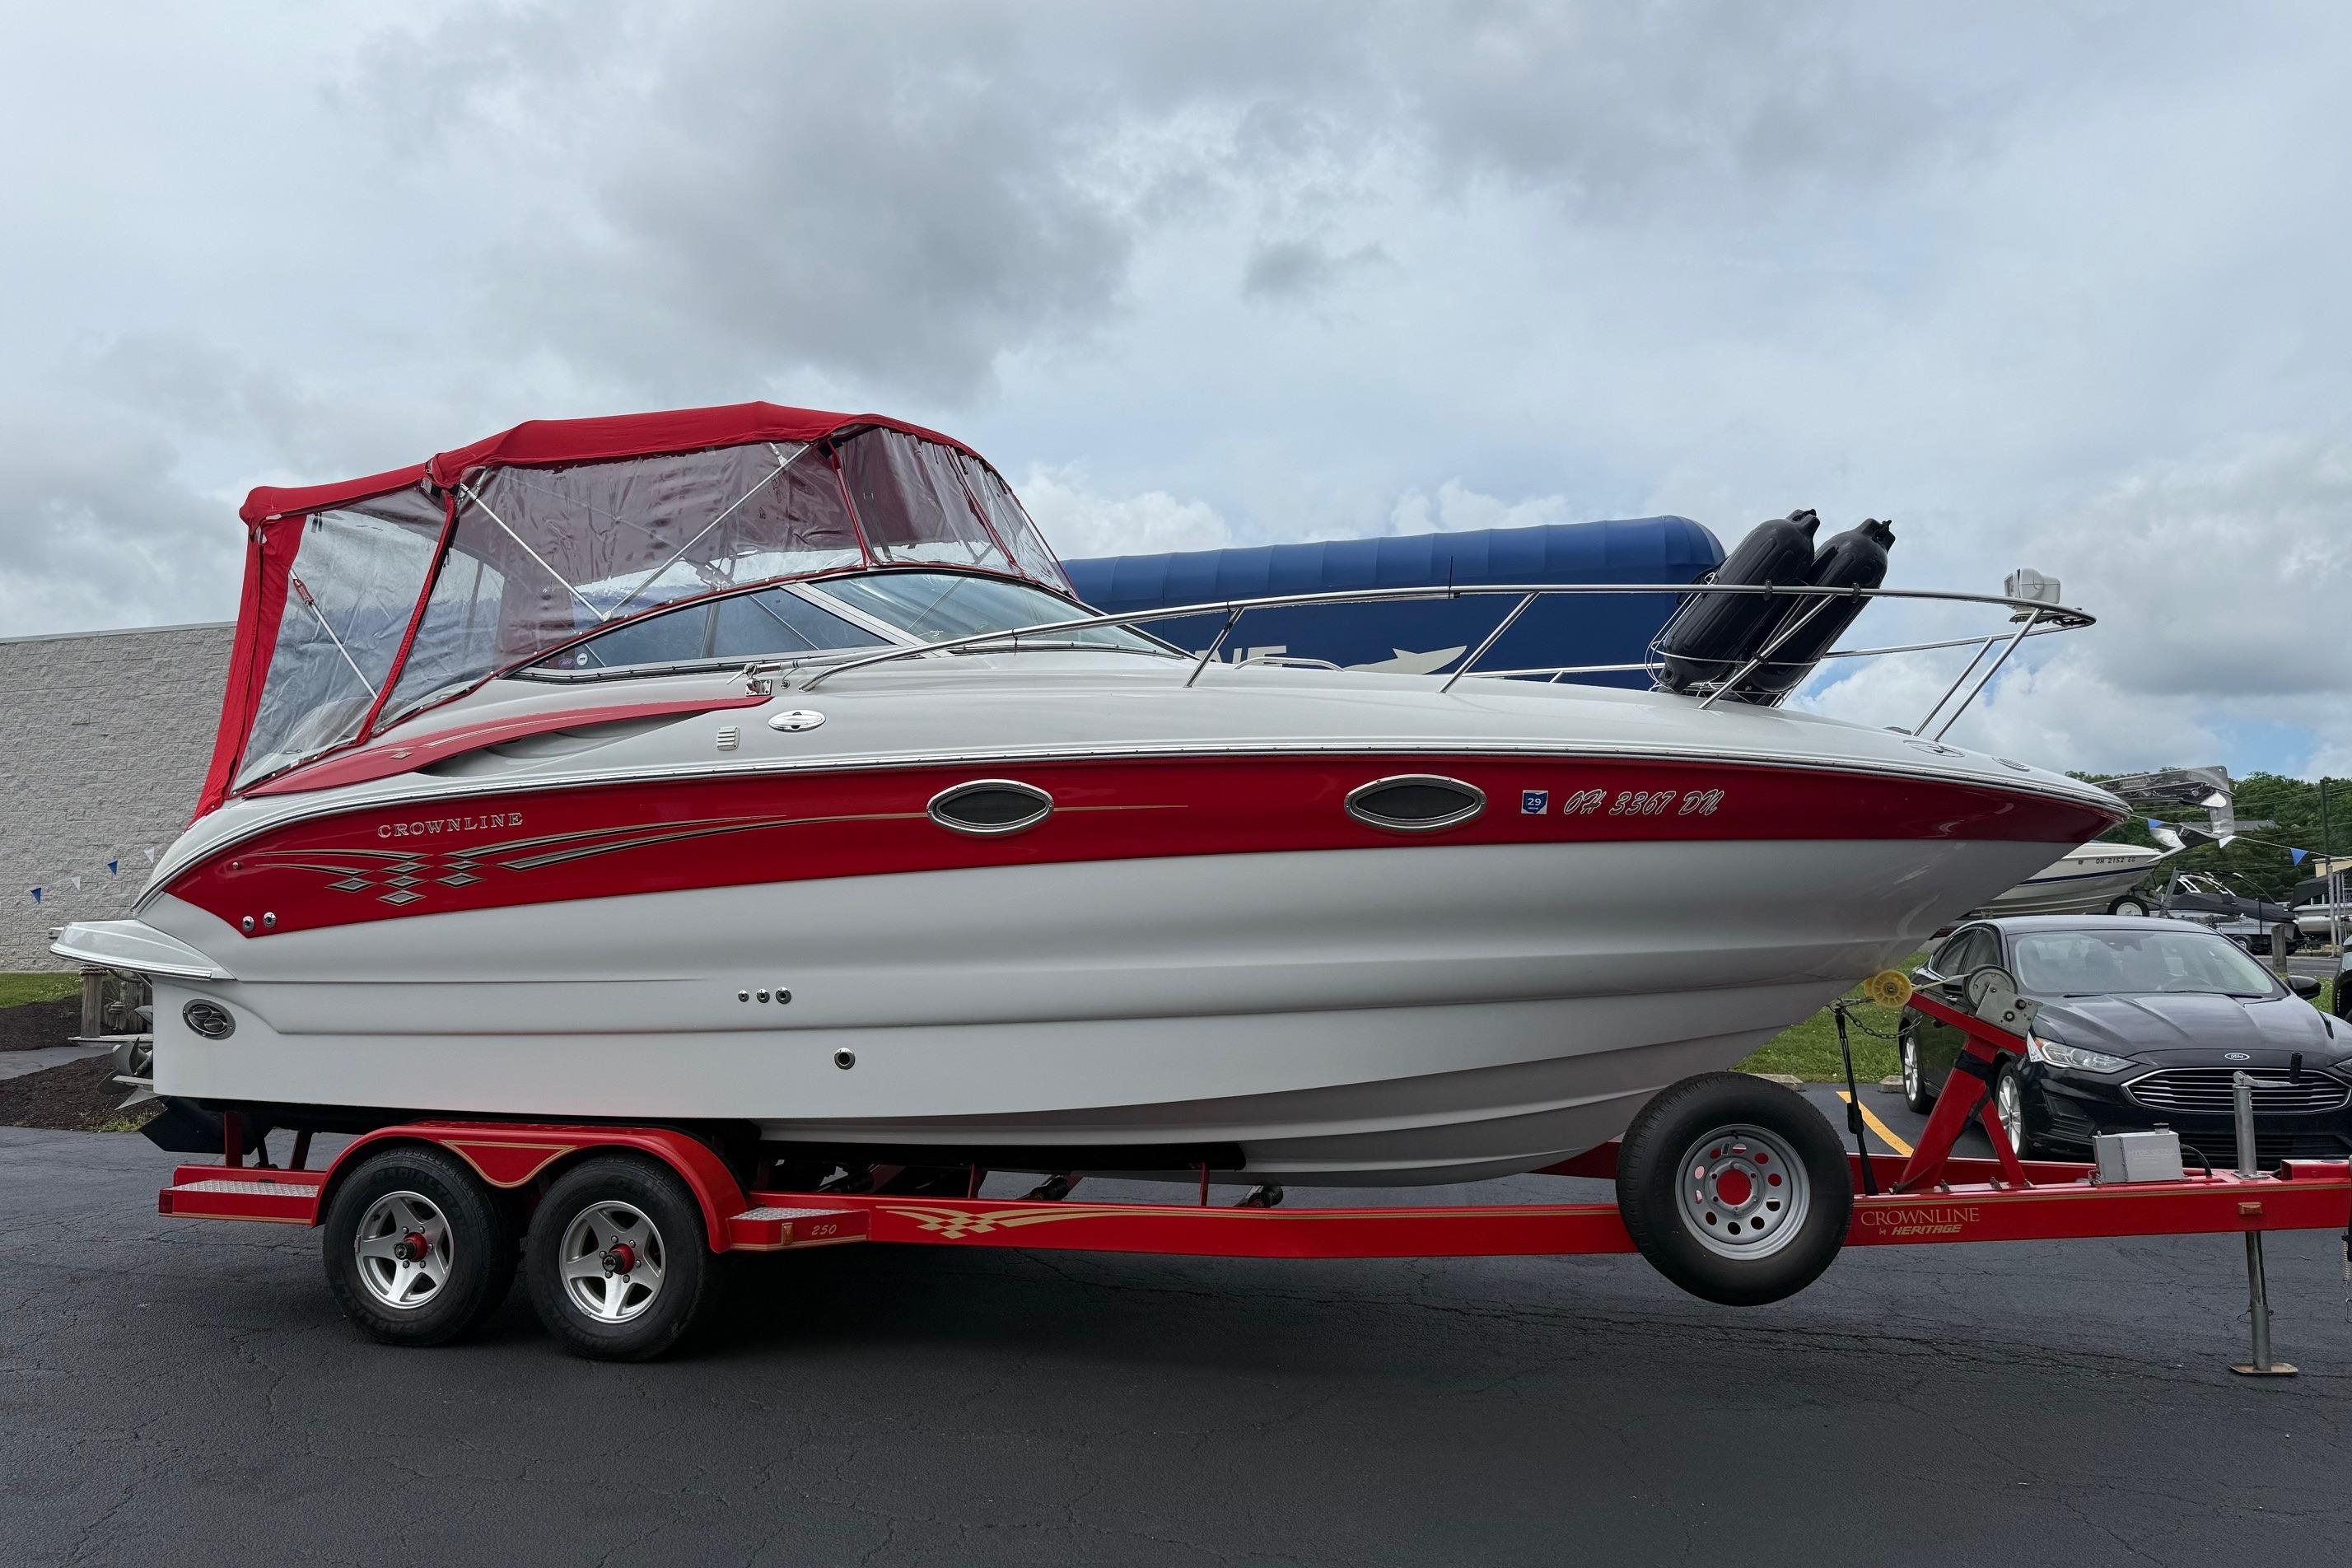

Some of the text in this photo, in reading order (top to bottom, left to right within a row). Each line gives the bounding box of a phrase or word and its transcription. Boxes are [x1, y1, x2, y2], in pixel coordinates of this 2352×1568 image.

[1528, 797, 1542, 806] 29
[1563, 788, 1724, 816] OH 3367 DN
[377, 812, 524, 838] CROWNLINE
[1860, 1207, 1981, 1226] CROWNLINE
[811, 1224, 838, 1236] 250
[1891, 1224, 1962, 1236] HERITAGE
